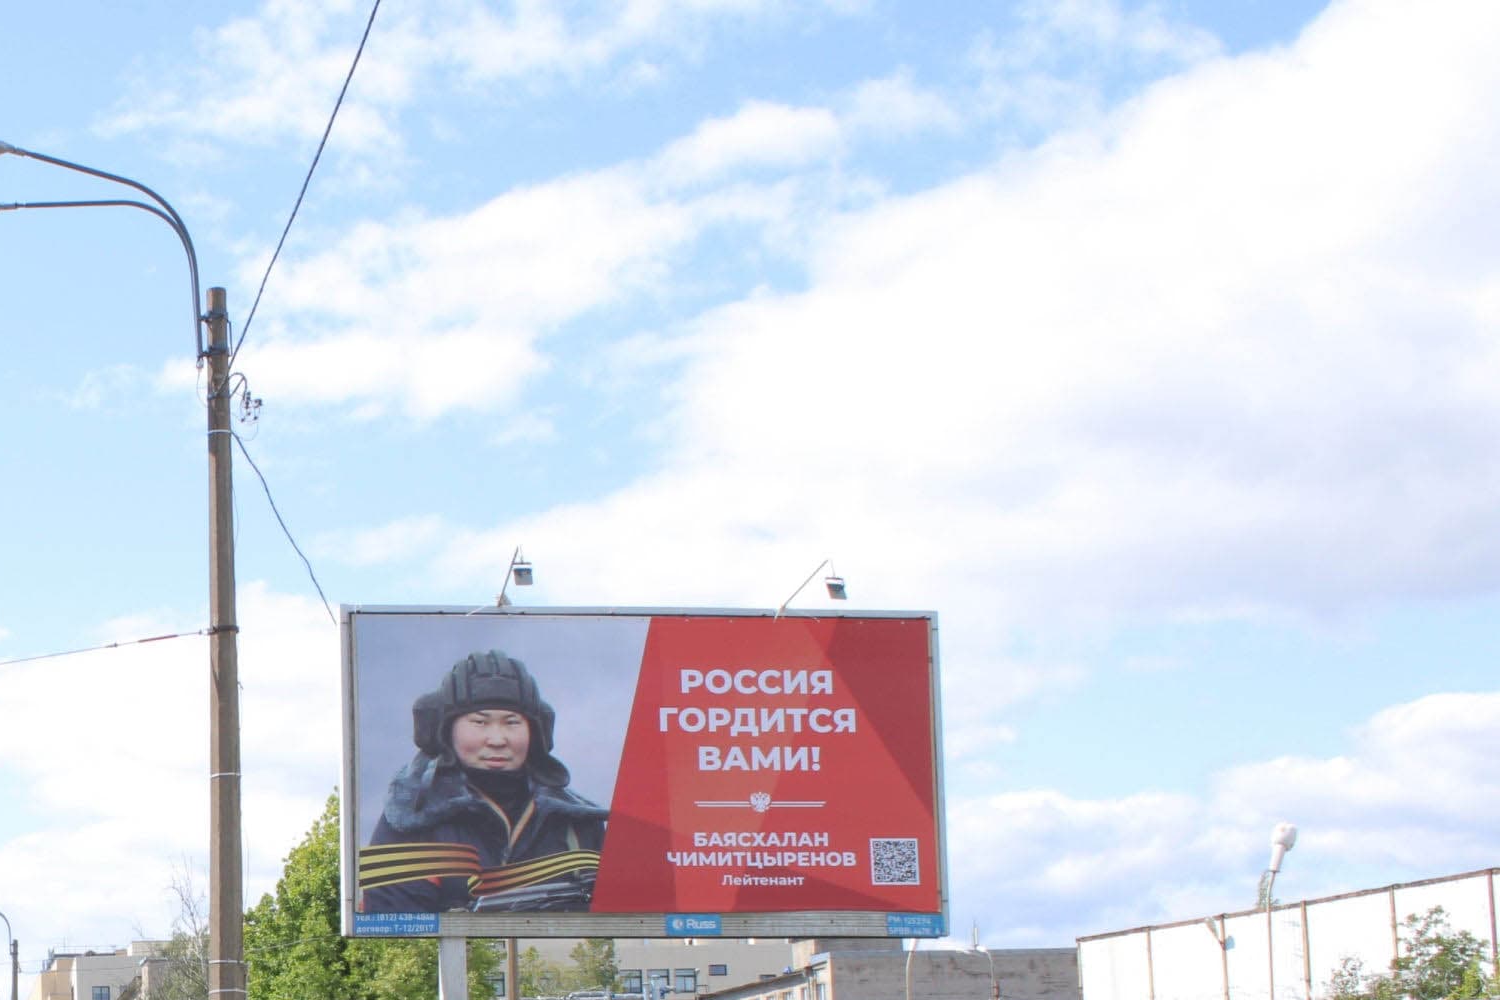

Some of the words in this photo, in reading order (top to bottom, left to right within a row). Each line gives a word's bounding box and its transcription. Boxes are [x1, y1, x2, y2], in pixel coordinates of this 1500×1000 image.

[680, 669, 833, 694] РОССИЯ
[659, 707, 857, 737] ГОРДИТСЯ
[698, 746, 821, 771] ВАМИ!
[693, 832, 829, 847] БАЯСХАЛАН
[667, 851, 856, 869] ЧИМИТЦЫРЕНОВ
[721, 874, 805, 886] Лейтенант
[686, 918, 716, 929] Russ
